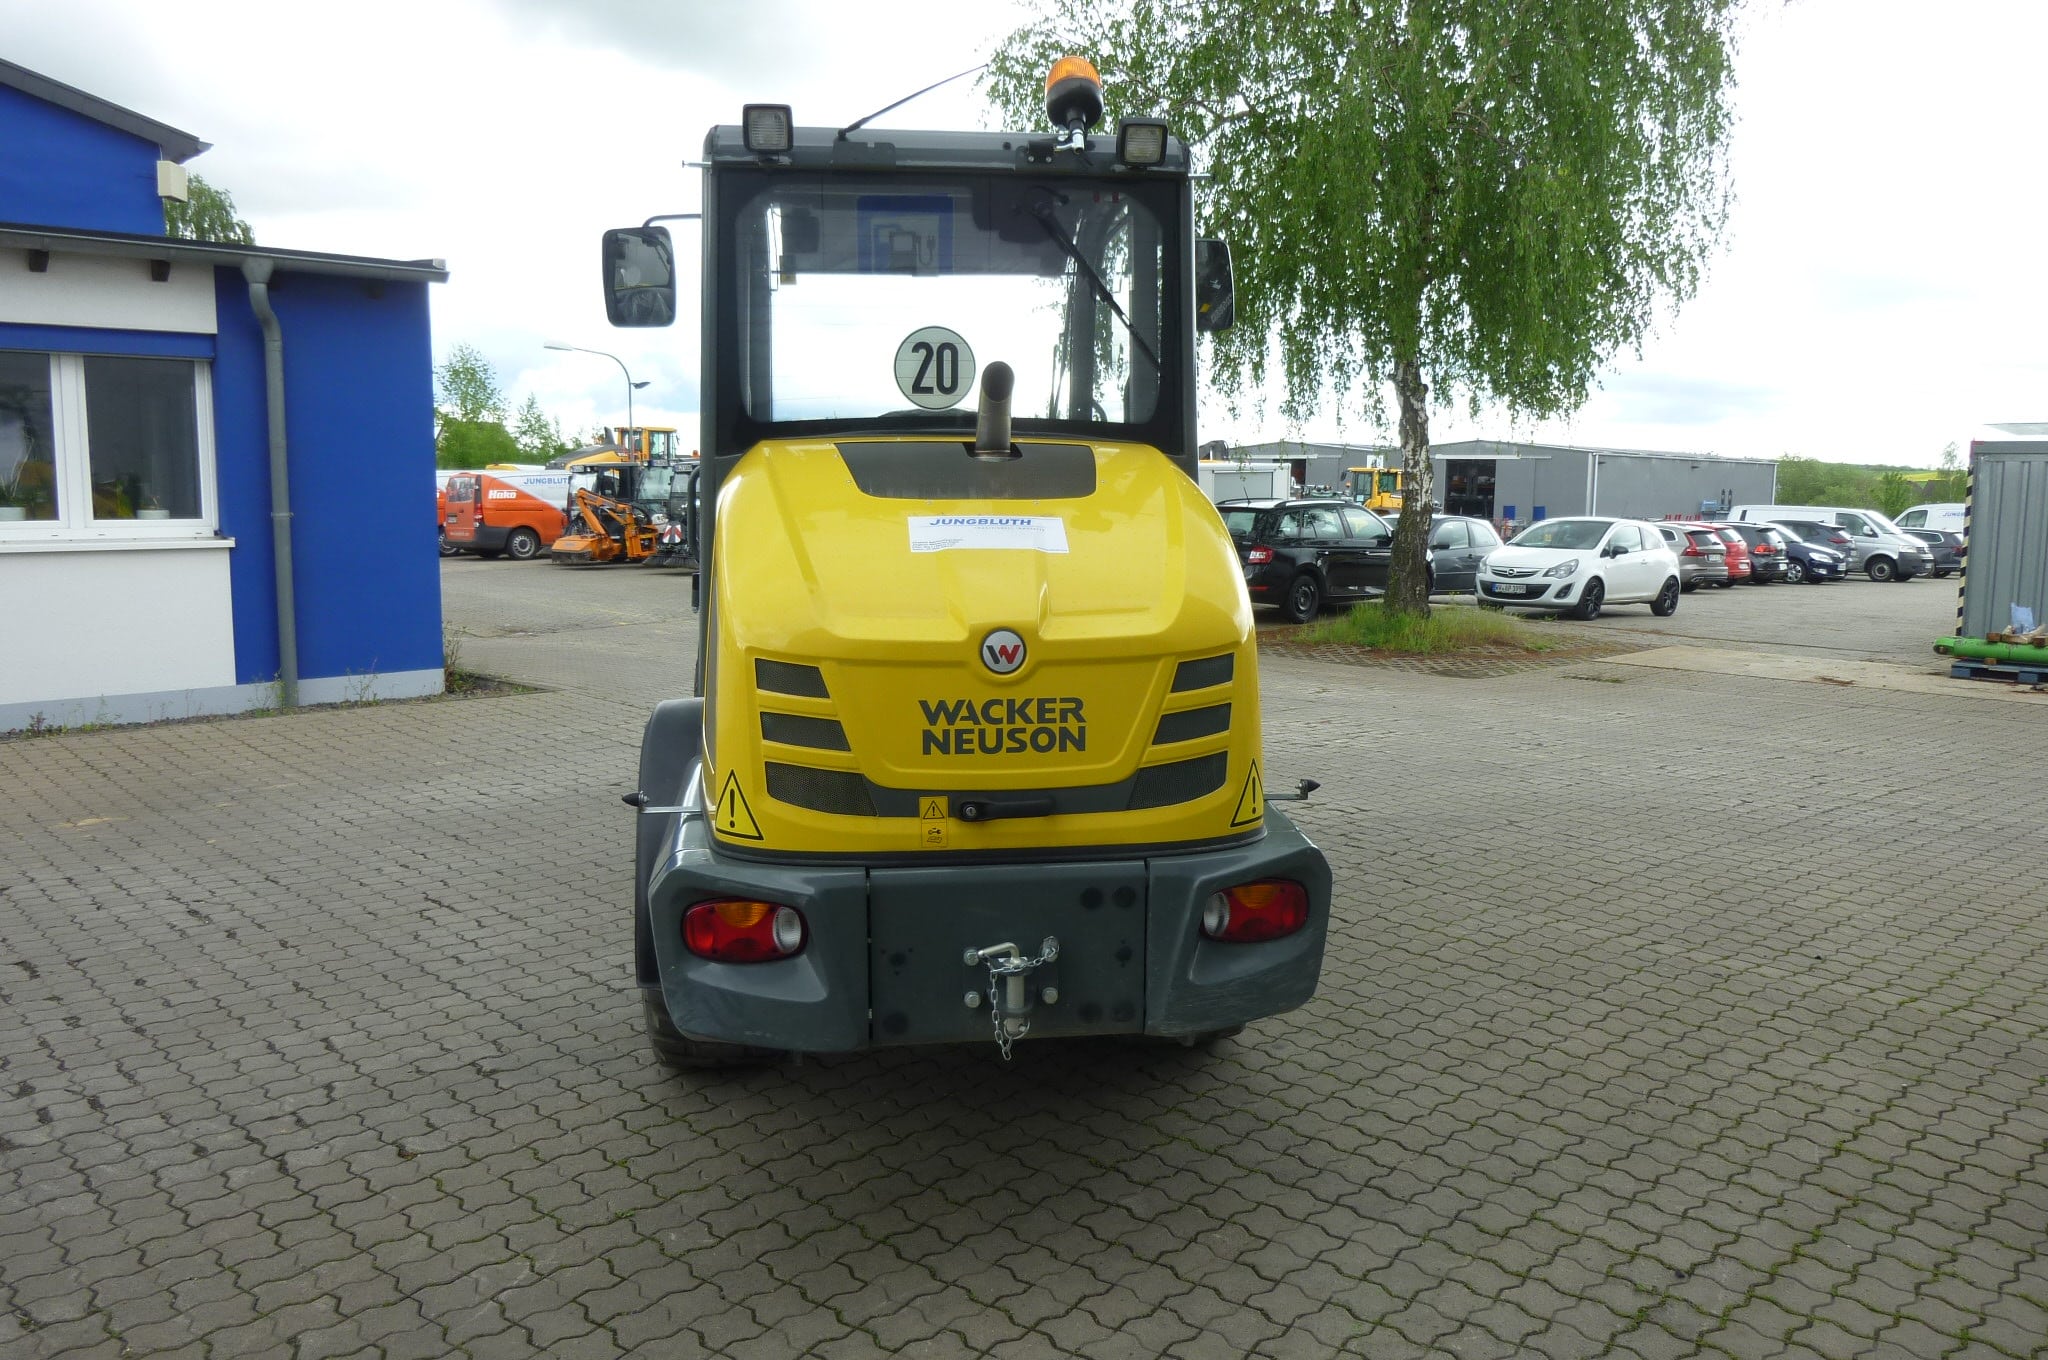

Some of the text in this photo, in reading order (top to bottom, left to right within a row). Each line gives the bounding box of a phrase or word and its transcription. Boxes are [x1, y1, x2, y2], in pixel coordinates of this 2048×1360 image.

[911, 341, 959, 395] 20
[524, 477, 570, 485] JUNGBLUT
[488, 489, 517, 500] Hako
[929, 518, 1032, 526] JUNGBLUTH
[918, 697, 1087, 726] WACKER
[922, 726, 1086, 756] NEUSON
